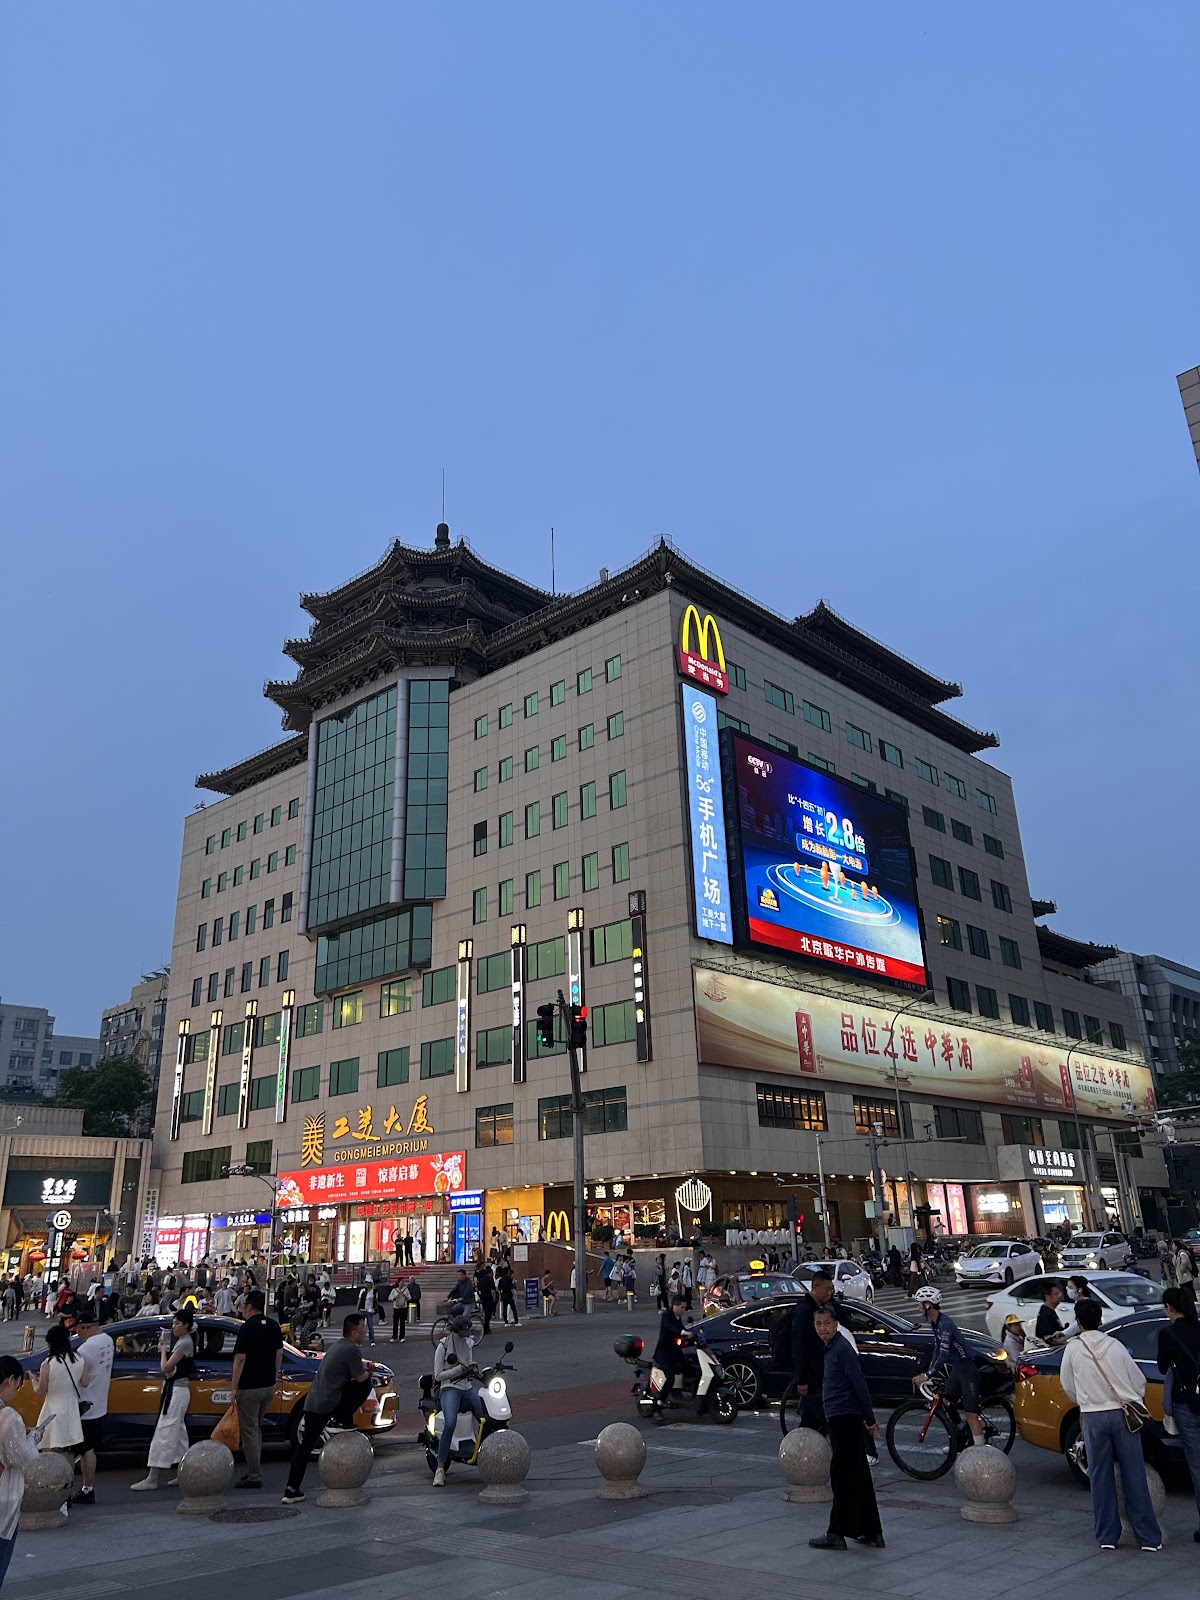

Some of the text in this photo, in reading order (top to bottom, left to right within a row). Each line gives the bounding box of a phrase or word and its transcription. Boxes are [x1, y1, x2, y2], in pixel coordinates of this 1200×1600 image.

[687, 655, 722, 679] McDonald's
[687, 664, 724, 689] 麦当劳
[699, 726, 709, 771] 中国移动
[698, 795, 721, 905] 手机广场
[701, 907, 726, 922] 工美大厦
[702, 918, 727, 933] 地下一层
[800, 936, 887, 973] 北京歌华户外传媒
[840, 1011, 919, 1064] 品位之选
[1074, 1060, 1107, 1086] 品位之选
[332, 1094, 434, 1142] 工美大厦
[309, 1172, 345, 1191] 非遗新生
[377, 1163, 419, 1184] 惊喜启幕
